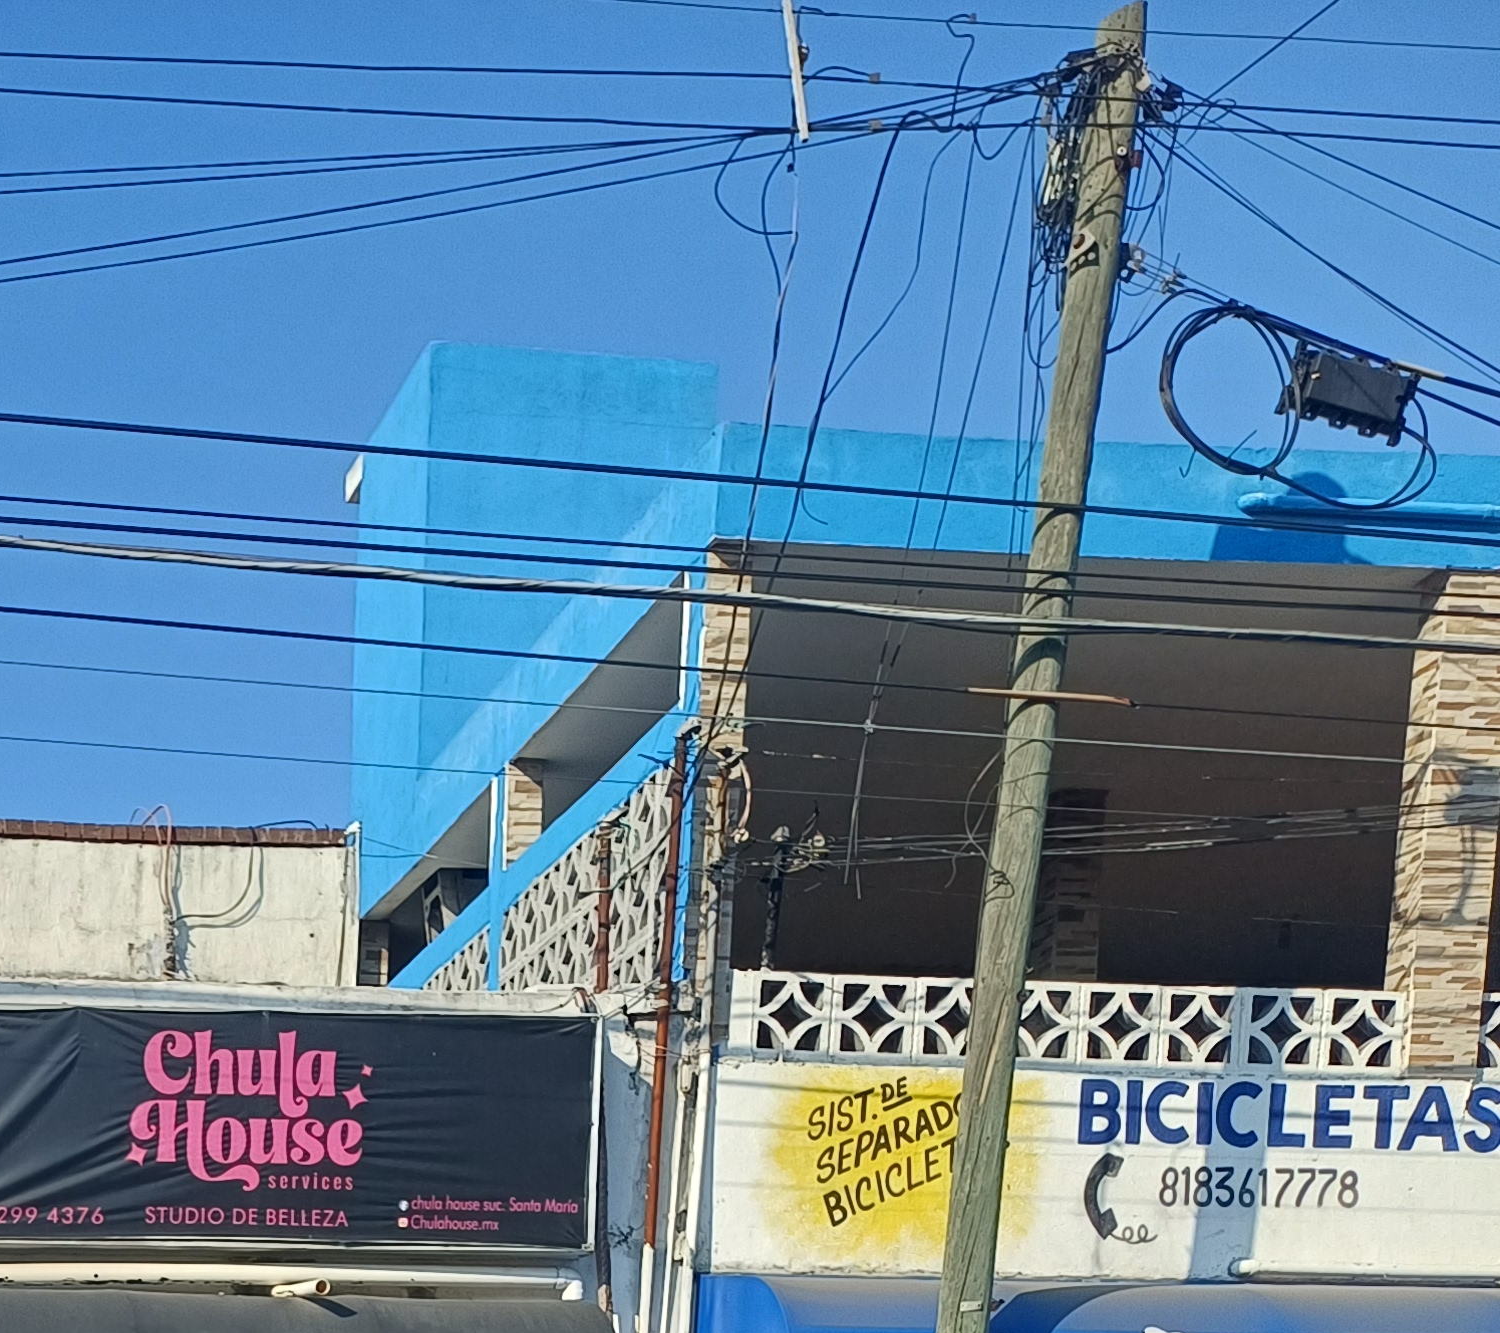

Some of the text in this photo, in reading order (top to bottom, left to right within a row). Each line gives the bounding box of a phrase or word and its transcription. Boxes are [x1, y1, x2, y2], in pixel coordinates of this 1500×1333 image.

[143, 1029, 337, 1118] Chula
[807, 1076, 908, 1140] SIST. DE
[1077, 1078, 1500, 1154] BICICLETAS
[129, 1098, 363, 1191] House
[267, 1172, 354, 1191] services
[1158, 1166, 1359, 1208] 8183617778
[46, 1206, 105, 1225] 4376
[144, 1206, 349, 1228] STUDIO DE BELLEZA
[445, 1195, 481, 1212] house
[509, 1197, 542, 1213] Santa
[410, 1215, 500, 1231] Chulahouse.mx
